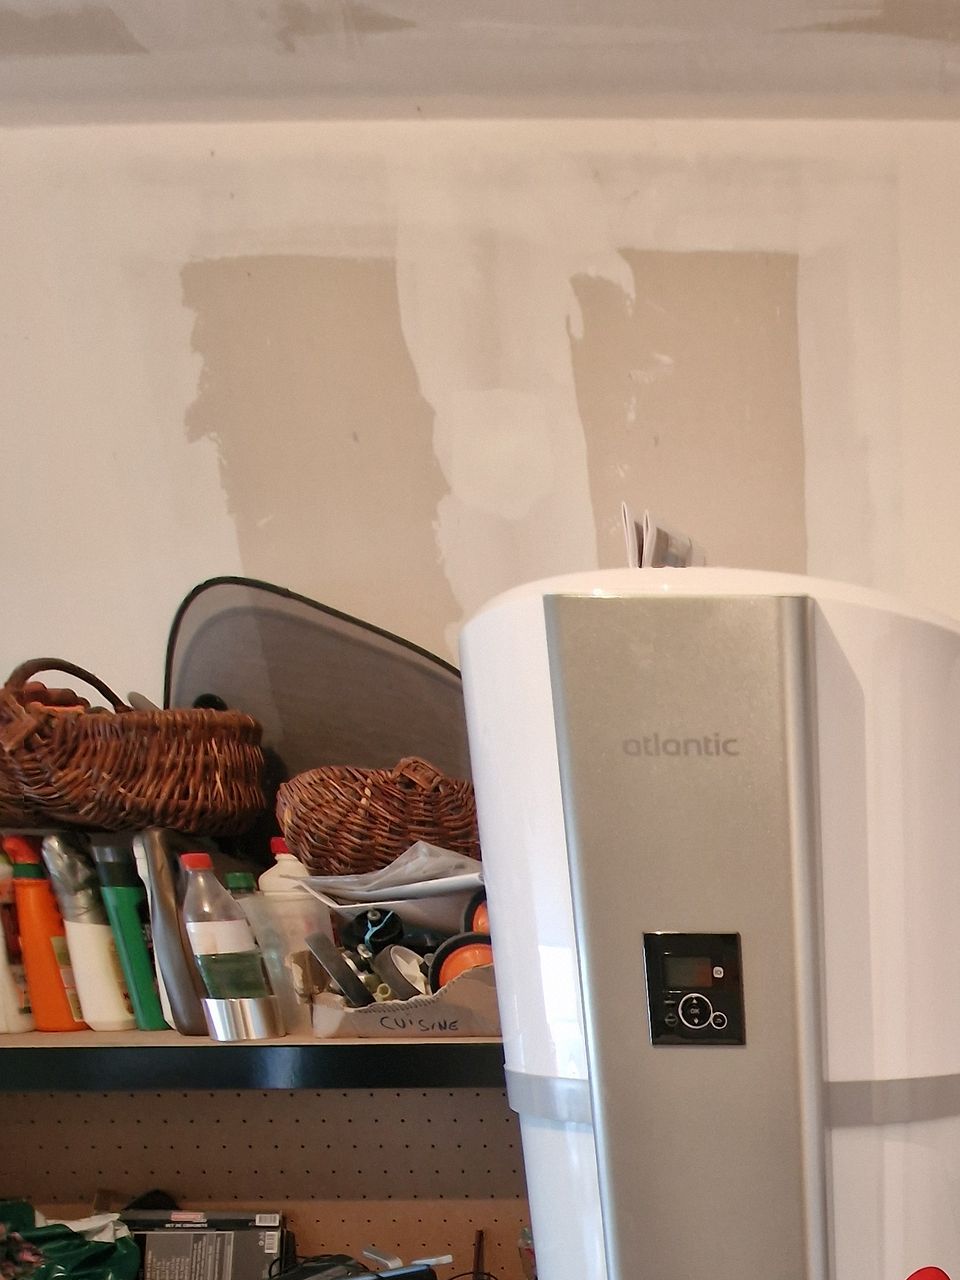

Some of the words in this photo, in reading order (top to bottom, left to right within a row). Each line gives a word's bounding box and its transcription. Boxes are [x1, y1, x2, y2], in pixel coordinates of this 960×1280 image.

[622, 732, 740, 756] atlantic
[690, 1007, 700, 1015] OK
[380, 1016, 459, 1032] CUISINE
